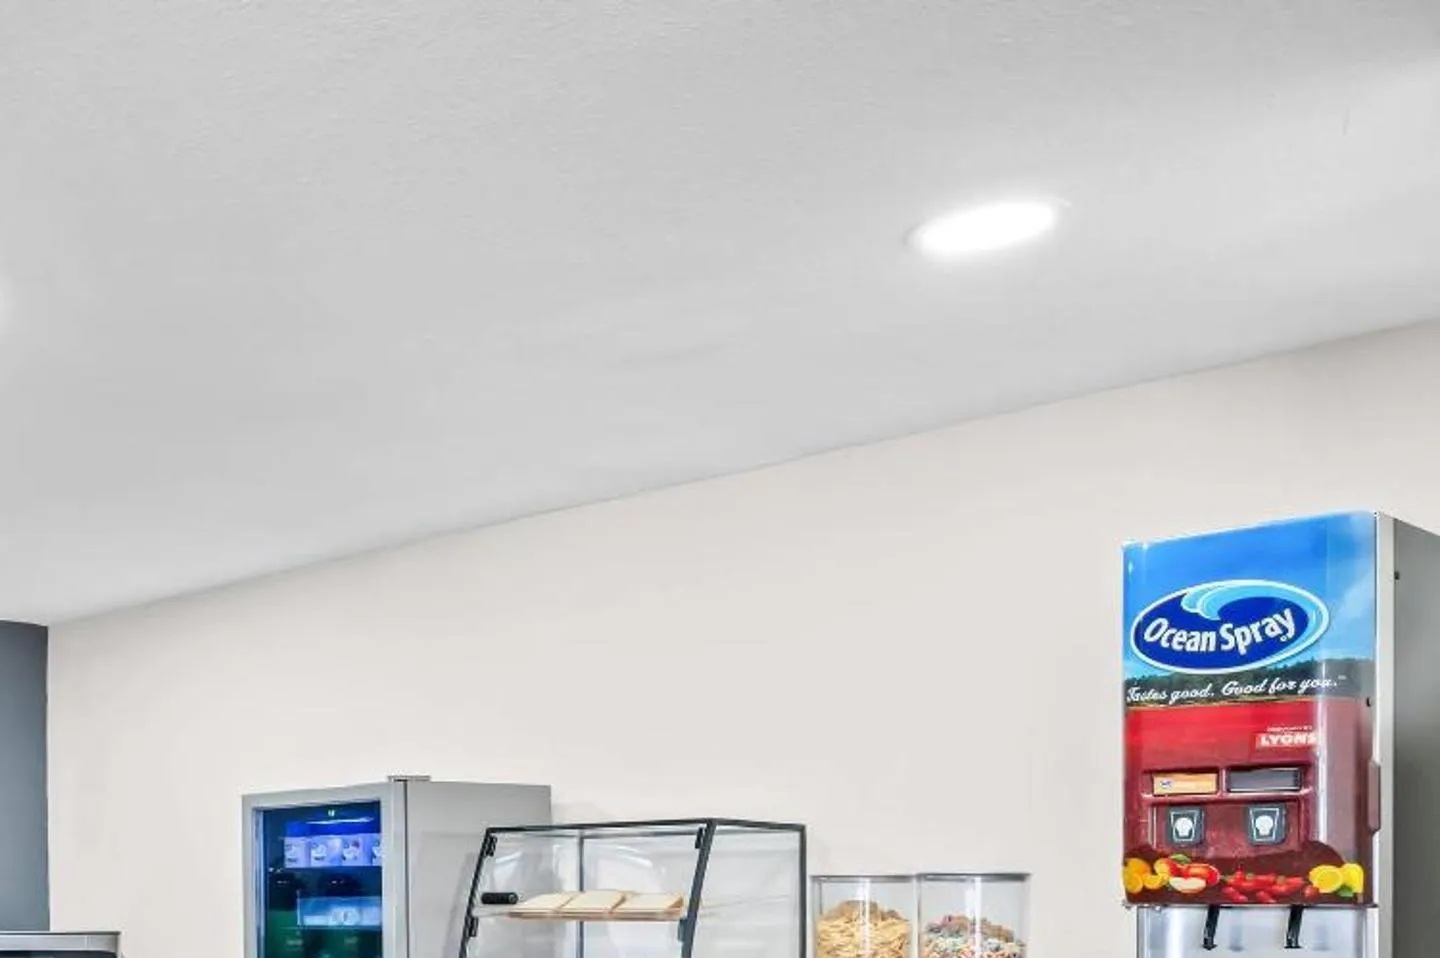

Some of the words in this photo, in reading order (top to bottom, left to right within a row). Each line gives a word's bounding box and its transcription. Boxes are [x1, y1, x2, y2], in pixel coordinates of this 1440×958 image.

[1143, 617, 1216, 652] Ocean
[1219, 607, 1296, 655] Spray
[1221, 678, 1266, 697] Good
